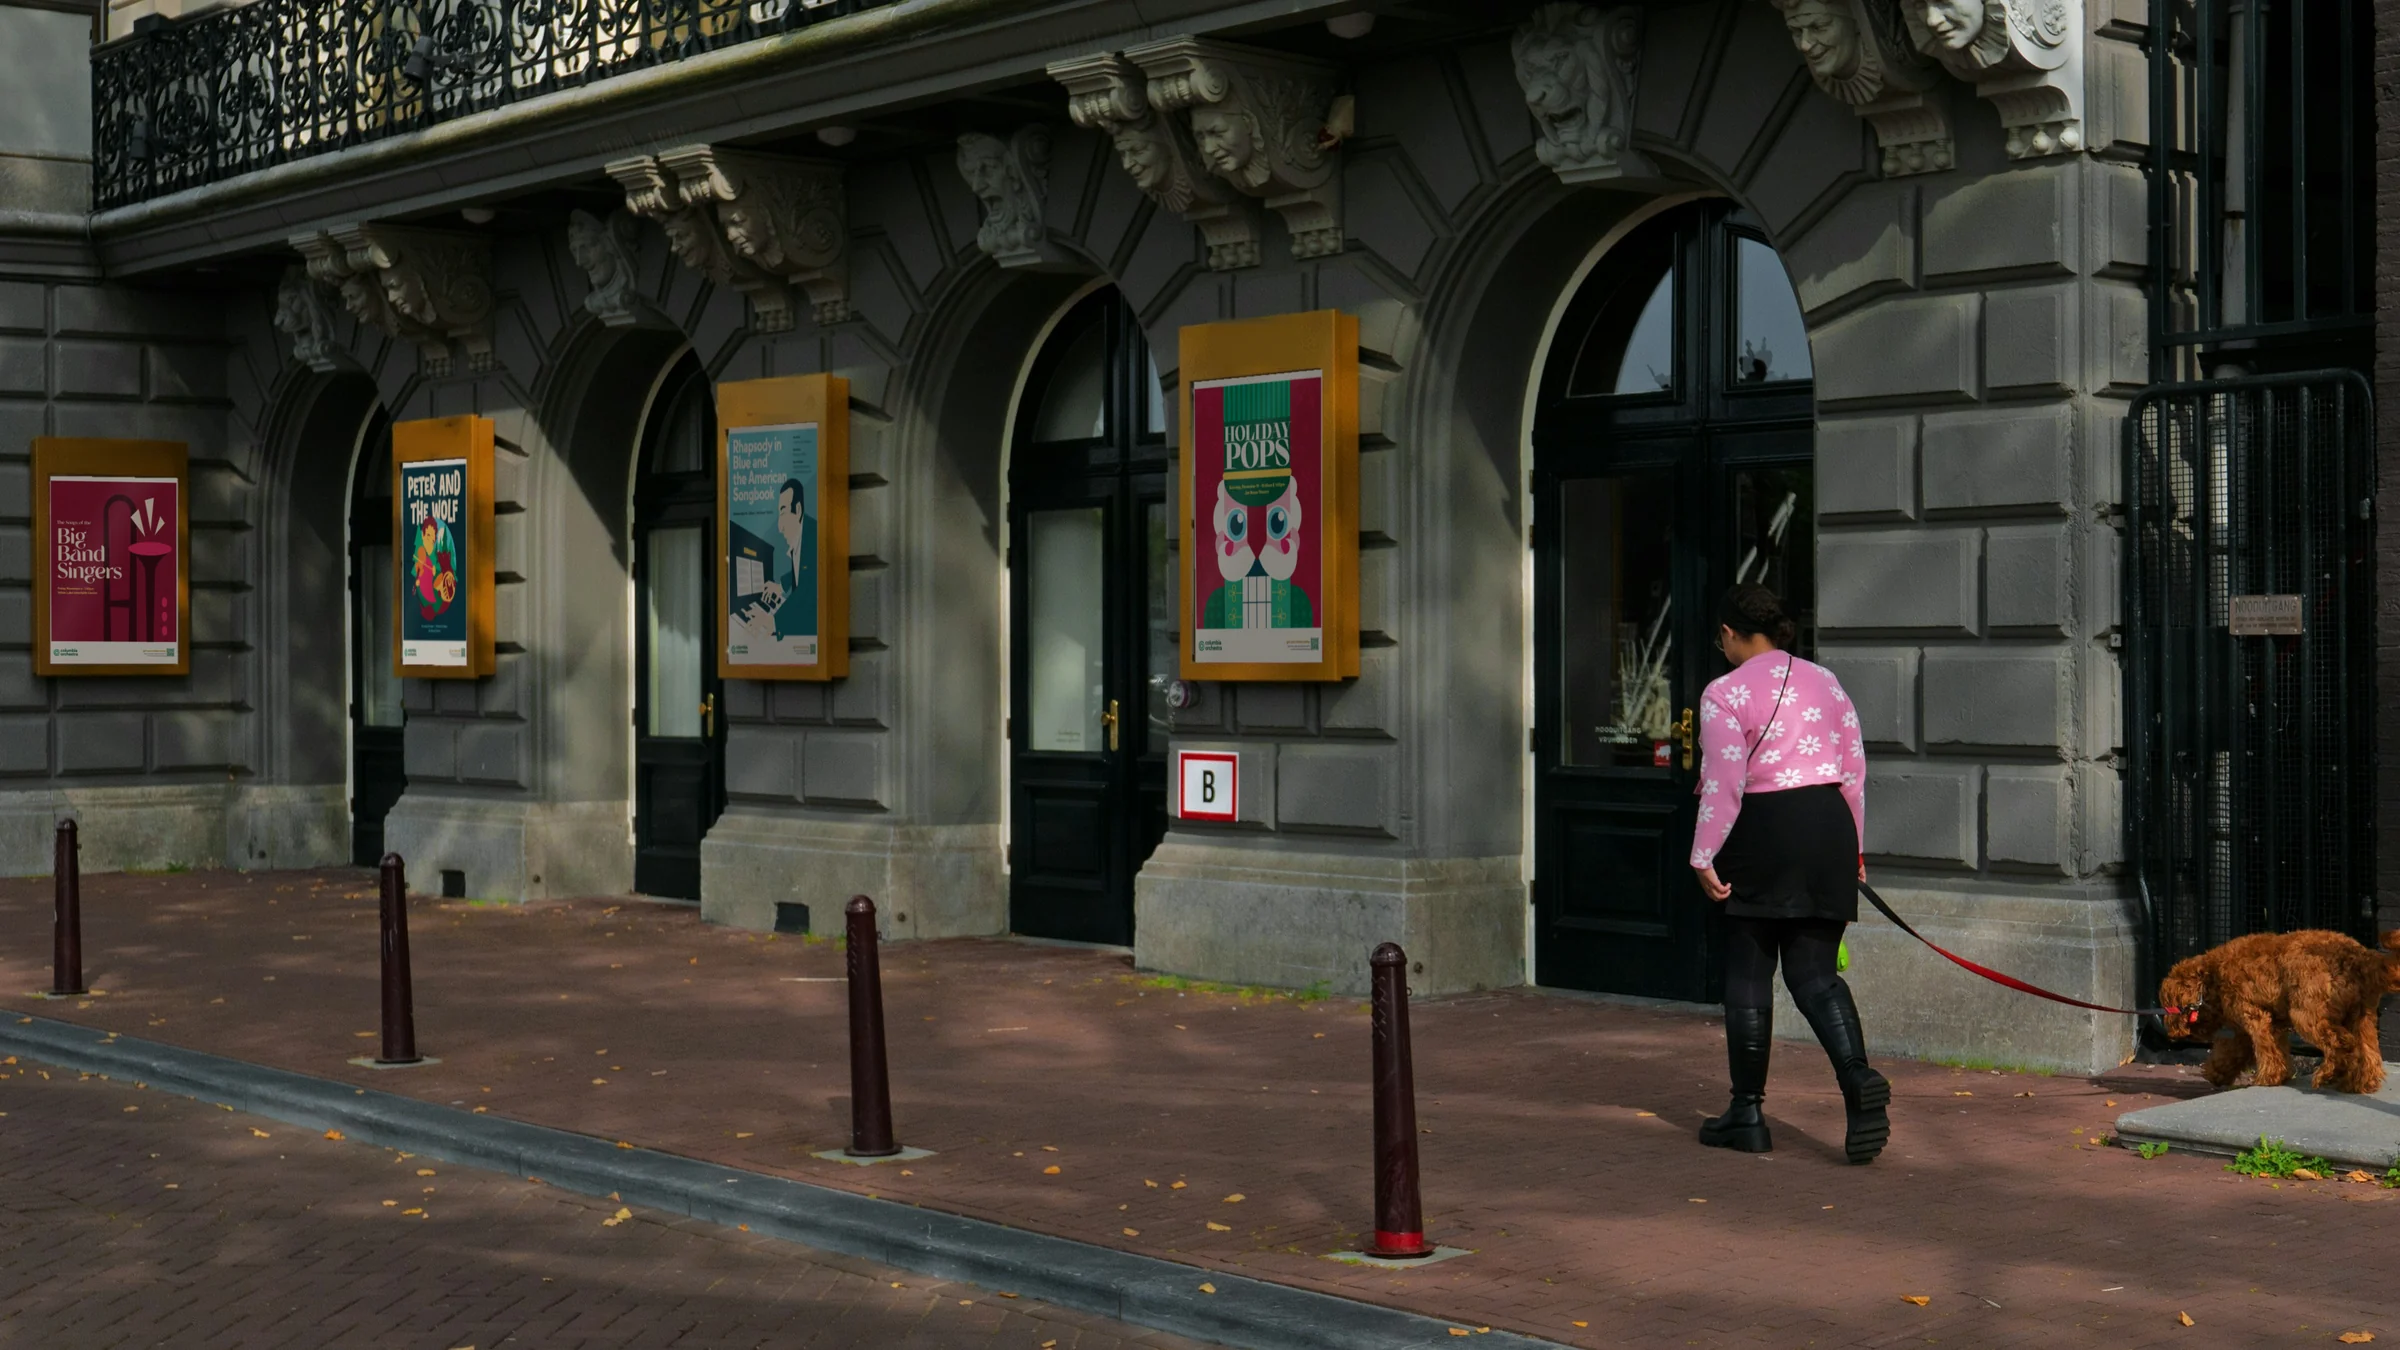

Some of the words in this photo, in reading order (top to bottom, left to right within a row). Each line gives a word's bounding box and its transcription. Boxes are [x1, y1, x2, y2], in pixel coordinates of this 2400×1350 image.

[1224, 421, 1291, 443] HOLIDAY
[733, 437, 773, 457] Rhapsody
[774, 436, 782, 451] in
[1224, 438, 1290, 470] POPS
[733, 455, 751, 470] Blue
[752, 455, 768, 468] and
[408, 473, 436, 498] PETER
[439, 469, 461, 497] AND
[733, 471, 747, 486] the
[748, 470, 787, 485] American
[733, 486, 775, 505] Songbook
[410, 499, 429, 525] THE
[431, 498, 459, 523] WOLF
[58, 527, 87, 549] Big
[58, 545, 105, 562] Band
[58, 562, 123, 584] Singers
[2235, 600, 2297, 613] NOODUITGANG
[1203, 770, 1215, 803] B
